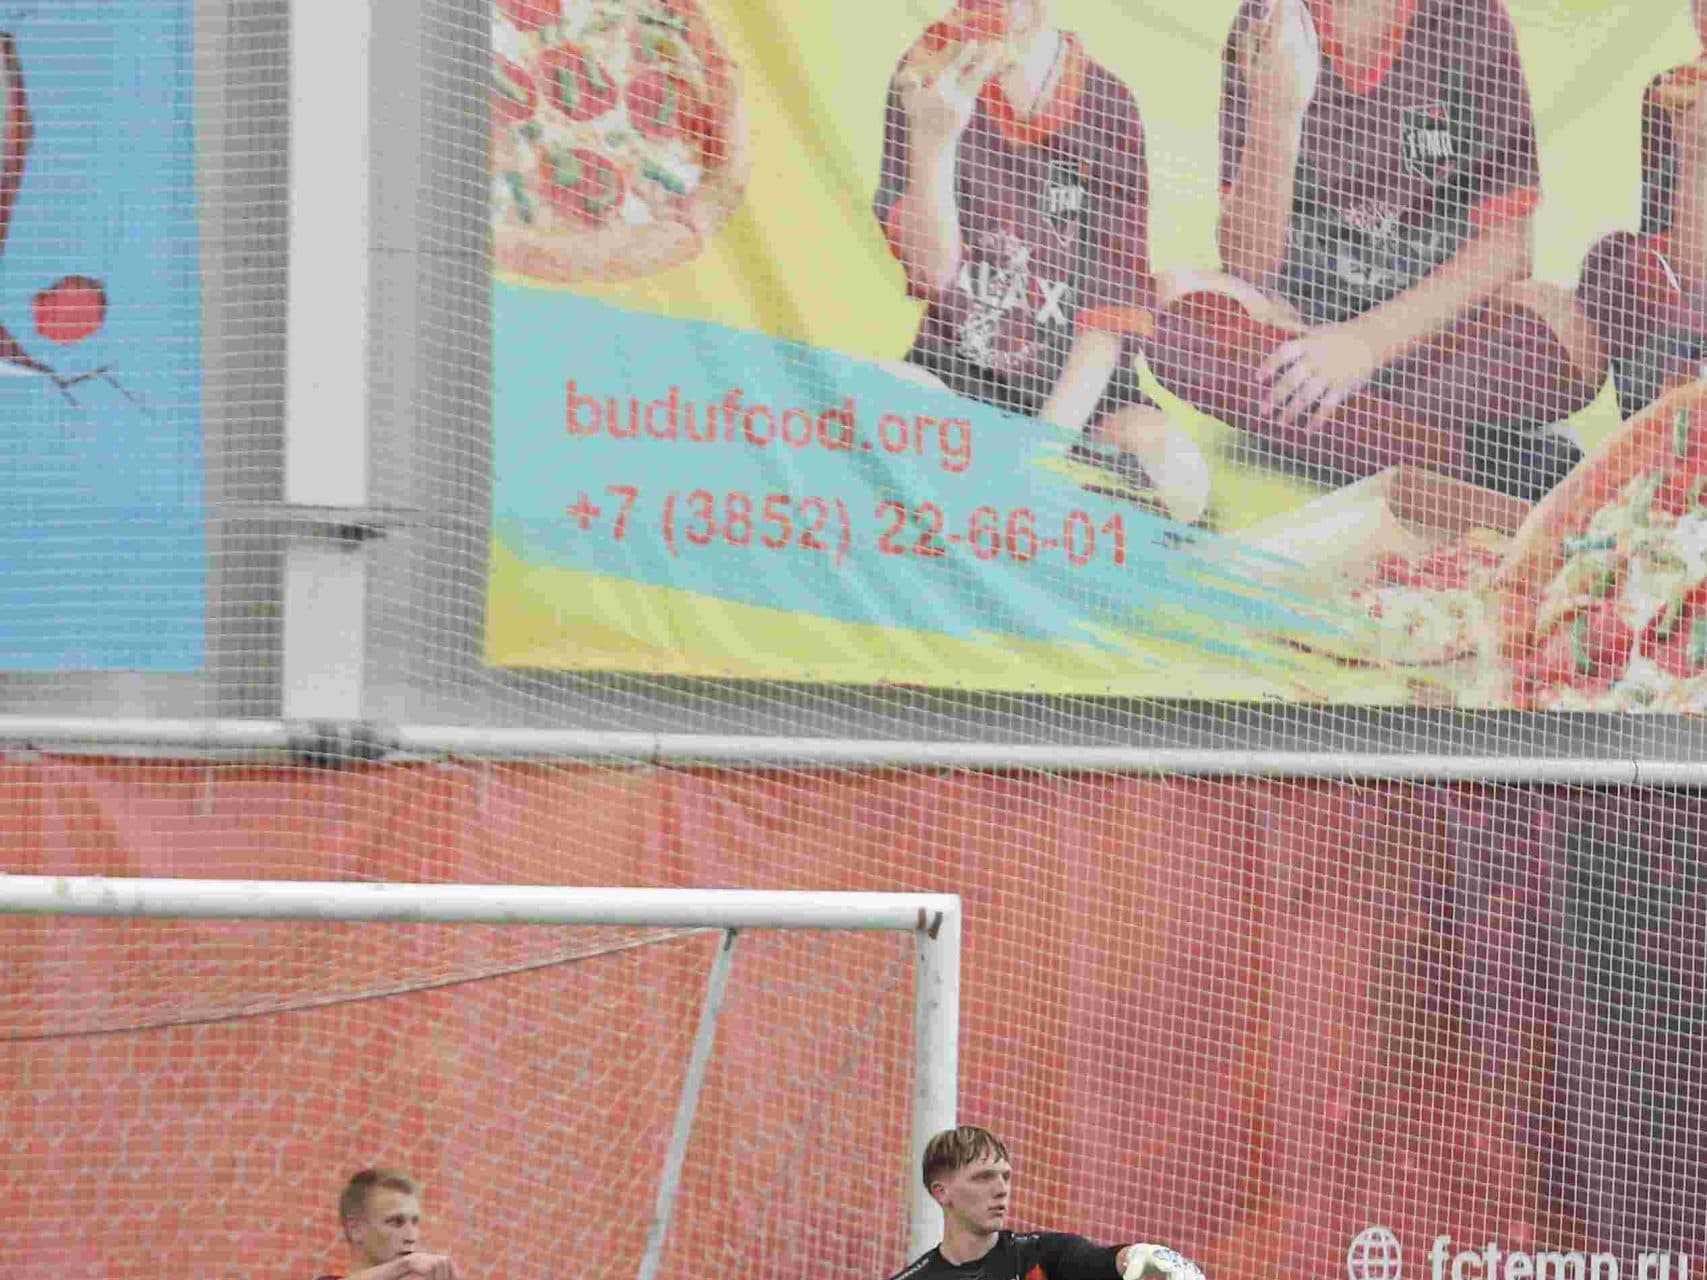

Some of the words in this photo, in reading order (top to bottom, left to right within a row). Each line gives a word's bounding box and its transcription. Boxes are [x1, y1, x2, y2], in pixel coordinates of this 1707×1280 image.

[566, 380, 972, 472] budufood.org
[567, 485, 639, 541] +7
[662, 489, 852, 567] (3852)
[874, 501, 1127, 567] 22-66-01
